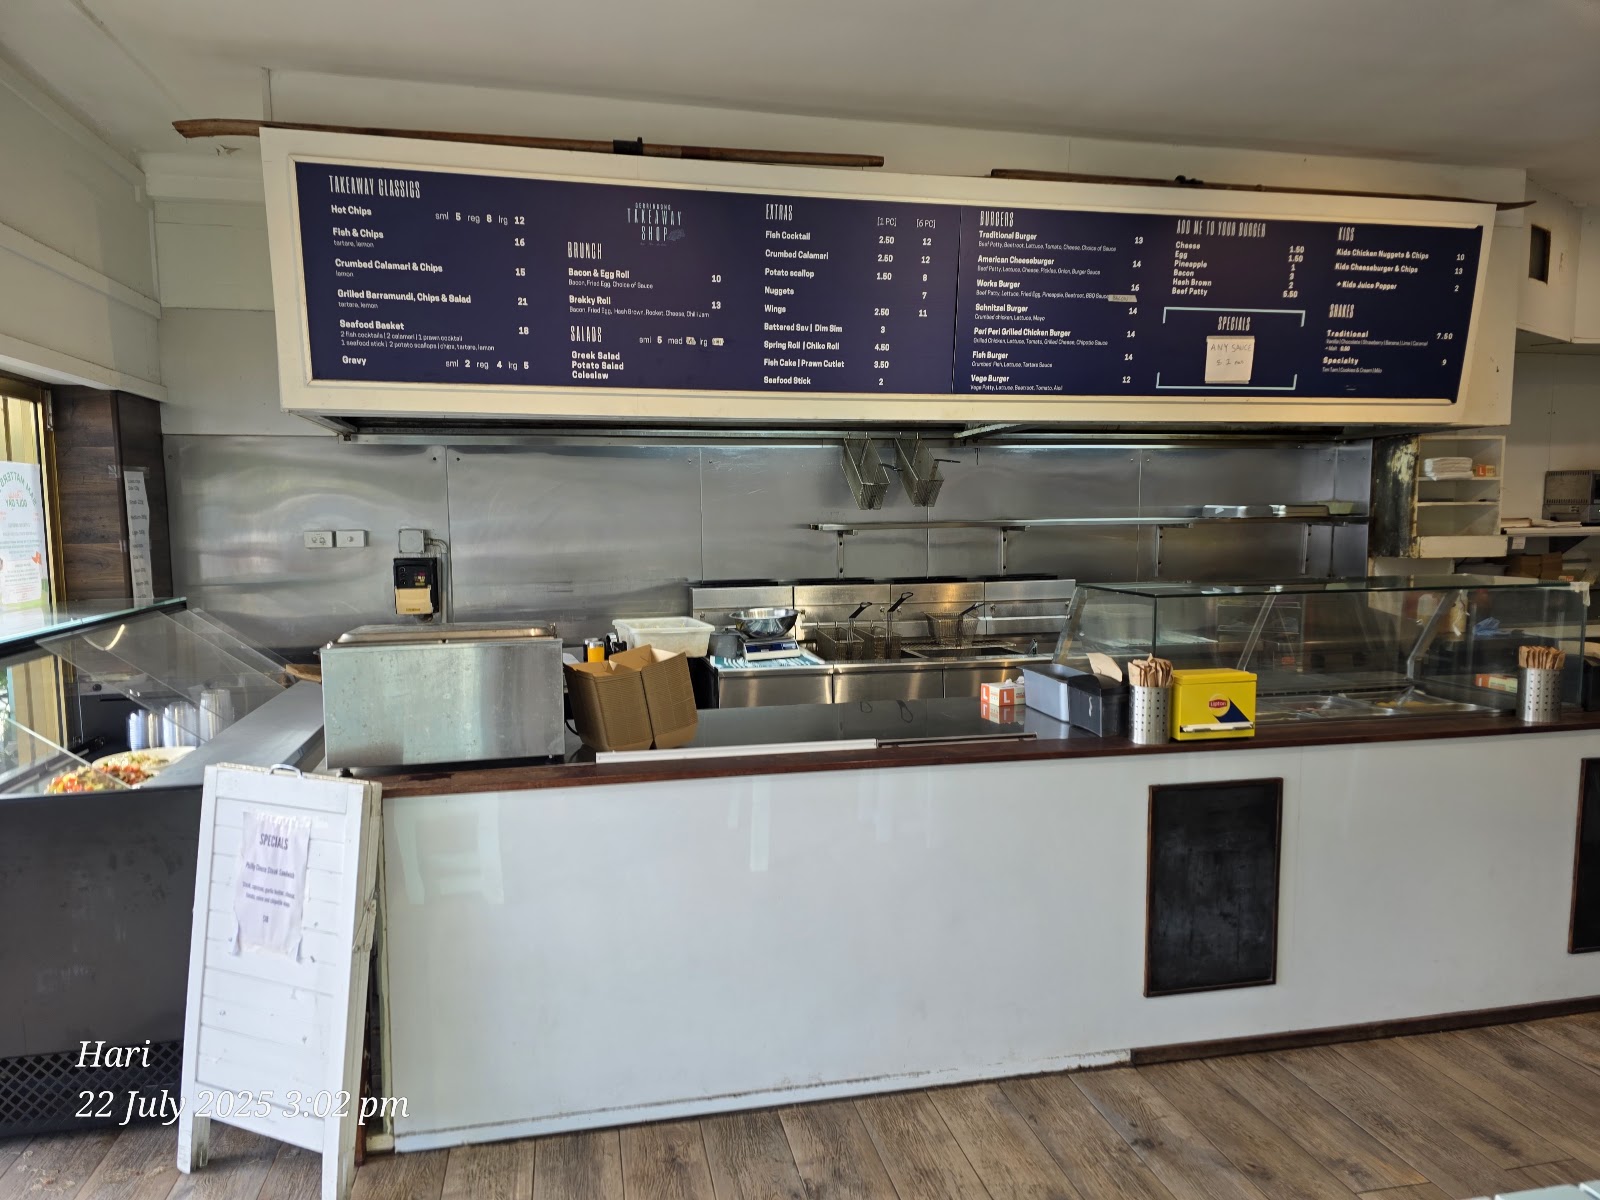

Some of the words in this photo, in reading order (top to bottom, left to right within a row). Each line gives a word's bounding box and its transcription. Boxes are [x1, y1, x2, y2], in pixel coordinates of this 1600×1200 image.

[329, 175, 373, 195] TAKEAWAY
[331, 205, 346, 214] Hot
[348, 206, 372, 217] Chips
[766, 204, 792, 221] EXTRAS
[436, 212, 448, 220] sml
[468, 215, 480, 224] reg
[515, 216, 524, 225] 12
[627, 208, 682, 226] TAKEAWAY
[980, 211, 1013, 227] BURGERS
[642, 226, 668, 242] SHOP
[1177, 220, 1190, 234] ADD
[1194, 220, 1203, 235] ME
[1206, 221, 1214, 235] TO
[1218, 222, 1236, 236] YOUR
[1239, 222, 1266, 237] BURGER
[1338, 227, 1355, 241] KIDS
[333, 227, 350, 236] Fish
[360, 229, 384, 239] Chips
[515, 238, 525, 246] 16
[782, 231, 810, 240] Cocktail
[979, 230, 1014, 239] Traditional
[1015, 232, 1037, 241] Burger
[568, 242, 601, 259] BRUNCH
[1176, 241, 1200, 250] Cheese
[765, 249, 796, 258] Crumbed
[798, 251, 828, 259] Calamari
[1175, 250, 1187, 259] Egg
[1337, 248, 1351, 256] Kids
[1378, 250, 1404, 259] Nuggets
[1412, 252, 1429, 260] Chips
[335, 258, 373, 270] Crumbed
[375, 260, 410, 270] Calamari
[420, 263, 443, 273] Chips
[978, 255, 1008, 263] American
[1010, 256, 1054, 266] Cheeseburger
[1174, 260, 1207, 269] Pineapple
[569, 268, 591, 276] Bacon
[601, 269, 614, 279] Egg
[616, 270, 629, 278] Roll
[765, 268, 788, 276] Potato
[790, 269, 814, 279] scallop
[1350, 263, 1393, 273] Cheeseburger
[1401, 265, 1418, 273] Chips
[977, 279, 997, 287] Works
[999, 280, 1020, 289] Burger
[1375, 282, 1397, 290] Popper
[765, 286, 794, 296] Nuggets
[1189, 288, 1207, 296] Patty
[338, 289, 364, 298] Grilled
[366, 291, 415, 302] Barramundi,
[417, 293, 440, 303] Chips
[449, 294, 471, 303] Salad
[518, 297, 528, 305] 21
[569, 295, 595, 305] Brekky
[597, 296, 610, 304] Roll
[765, 304, 786, 314] Wings
[919, 309, 927, 317] 11
[976, 303, 1005, 311] Schnitzel
[1007, 304, 1028, 313] Burger
[1329, 304, 1354, 318] SHAKES
[340, 319, 374, 329] Seafood
[376, 321, 404, 330] Basket
[764, 323, 794, 331] Battered
[815, 324, 828, 332] Dim
[1218, 316, 1250, 331] SPECIALS
[571, 326, 601, 342] SALADS
[974, 327, 987, 335] Peri
[1050, 329, 1070, 339] Burger
[764, 340, 786, 350] Spring
[788, 341, 800, 349] Roll
[827, 342, 839, 350] Roll
[1210, 344, 1228, 352] ANY
[342, 356, 366, 366] Gravy
[572, 351, 595, 359] Greek
[598, 352, 620, 360] Salad
[987, 351, 1008, 362] Burger
[1323, 357, 1358, 365] Specialty
[572, 361, 599, 370] Potato
[602, 362, 624, 370] Salad
[764, 358, 778, 366] Fish
[801, 359, 822, 367] Prawn
[572, 370, 608, 379] Coleslaw
[764, 376, 792, 384] Seafood
[988, 375, 1009, 383] Burger
[1004, 691, 1010, 704] L
[259, 833, 288, 850] SPECIALS
